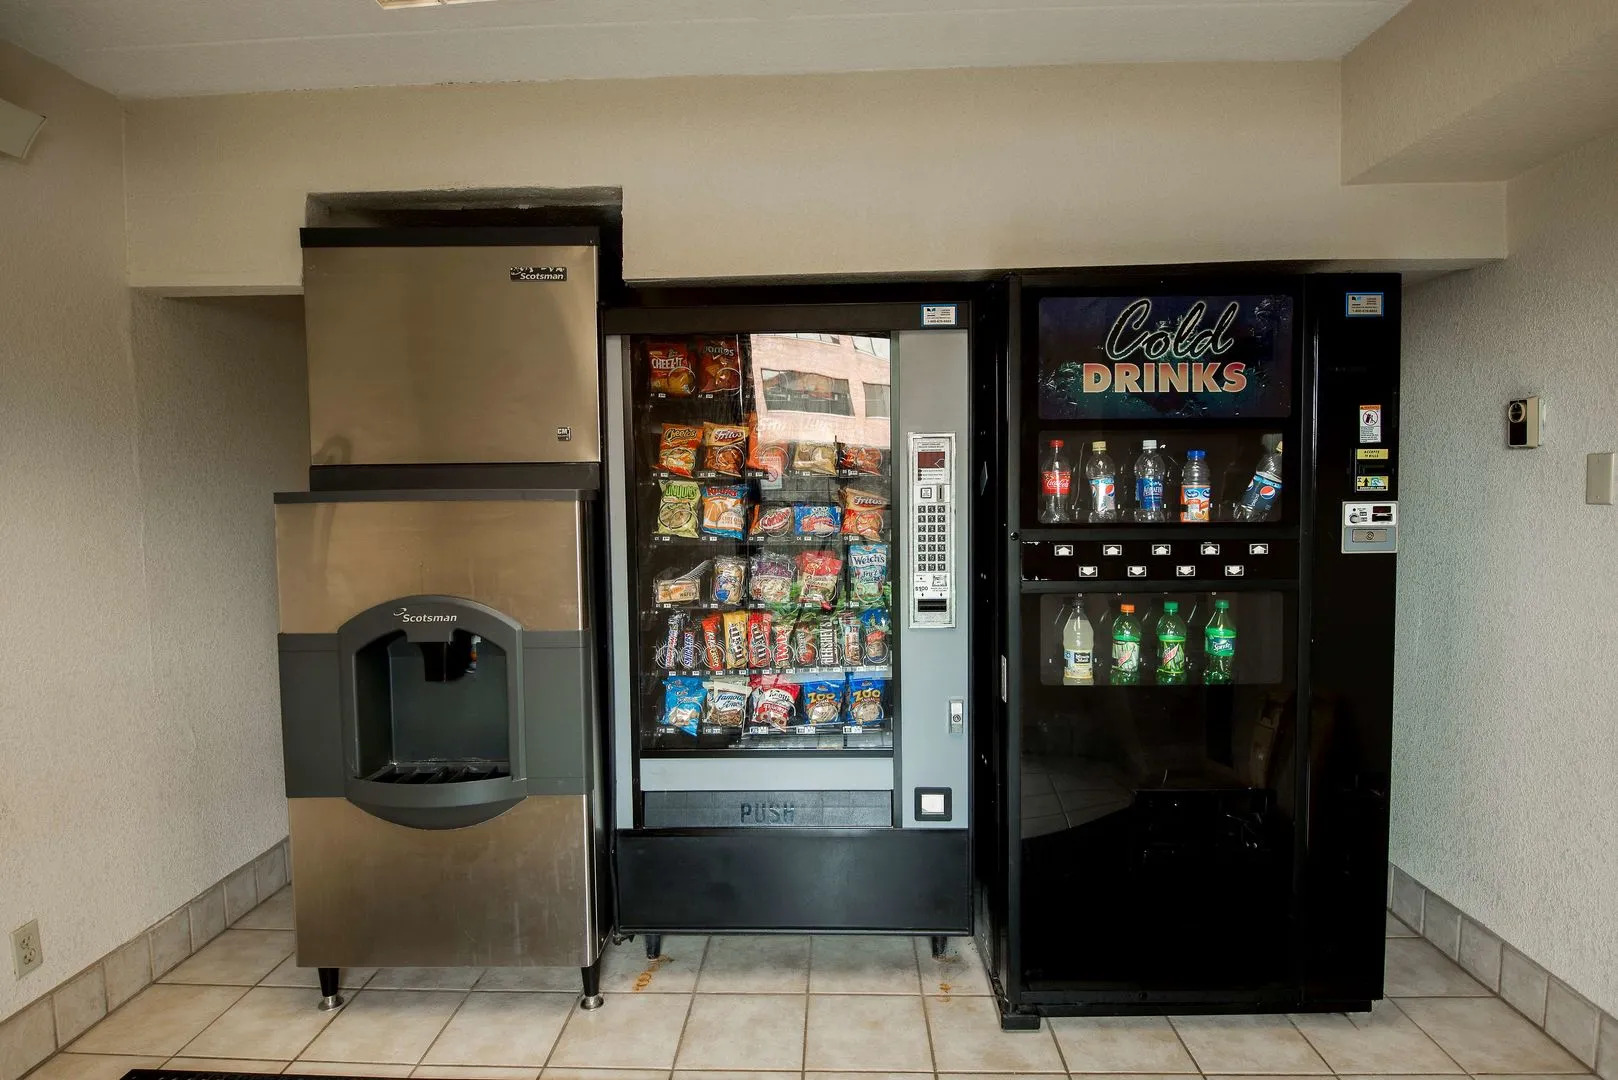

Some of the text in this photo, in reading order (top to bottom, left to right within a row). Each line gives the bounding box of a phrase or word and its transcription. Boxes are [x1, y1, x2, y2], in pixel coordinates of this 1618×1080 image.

[519, 272, 564, 280] Scotsman
[1105, 298, 1240, 361] Cold
[1082, 361, 1248, 393] DRINKS
[665, 428, 698, 443] Cheetos
[714, 429, 742, 441] Fritos
[853, 495, 882, 505] Fritos
[852, 554, 885, 565] Welch's
[402, 613, 457, 623] Scotsman
[820, 620, 833, 665] HERSHEY'S
[807, 692, 836, 703] ZOO
[852, 689, 881, 702] ZOO
[740, 802, 796, 824] PUSH
